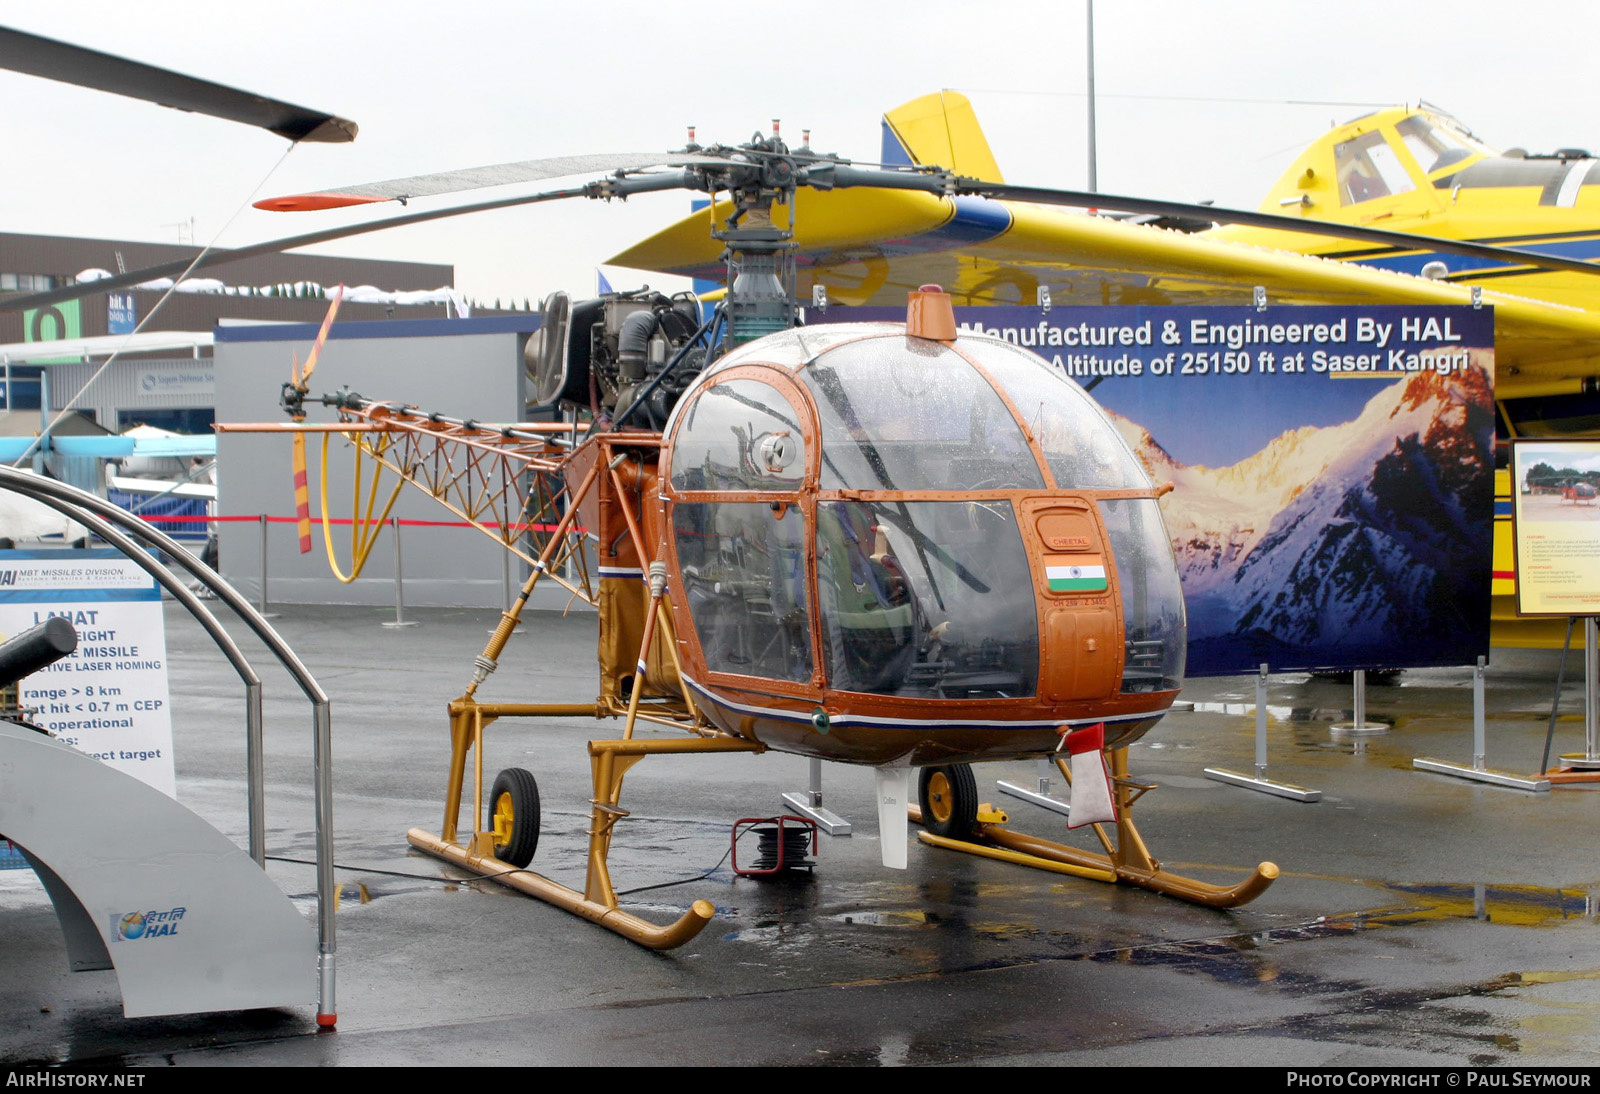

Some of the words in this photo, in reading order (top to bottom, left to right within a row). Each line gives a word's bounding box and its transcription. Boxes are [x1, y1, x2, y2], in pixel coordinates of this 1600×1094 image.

[1161, 319, 1181, 345] &
[1190, 318, 1346, 349] Engineered
[1356, 317, 1392, 347] By
[1401, 317, 1461, 342] HAL
[1052, 353, 1143, 376] Altitude
[1150, 353, 1175, 375] of
[1181, 351, 1250, 374] 25150
[1257, 351, 1275, 373] ft
[1282, 353, 1304, 373] at
[1311, 350, 1381, 372] Saser
[1387, 348, 1468, 375] Kangri
[1053, 538, 1088, 546] CHEETAL
[19, 569, 39, 577] MBT
[85, 568, 124, 576] DIVISION
[1053, 599, 1064, 607] CH
[83, 646, 139, 658] MISSILE
[75, 661, 112, 671] LASER
[115, 660, 162, 670] HOMING
[24, 688, 67, 701] range
[71, 687, 80, 696] >
[85, 685, 94, 696] 8
[99, 685, 121, 696] km
[50, 702, 70, 714] hit
[74, 703, 84, 712] <
[88, 702, 110, 712] 0.7
[115, 703, 129, 712] m
[133, 700, 163, 711] CEP
[49, 717, 134, 732] operational
[119, 748, 162, 762] target
[144, 923, 178, 939] HAL
